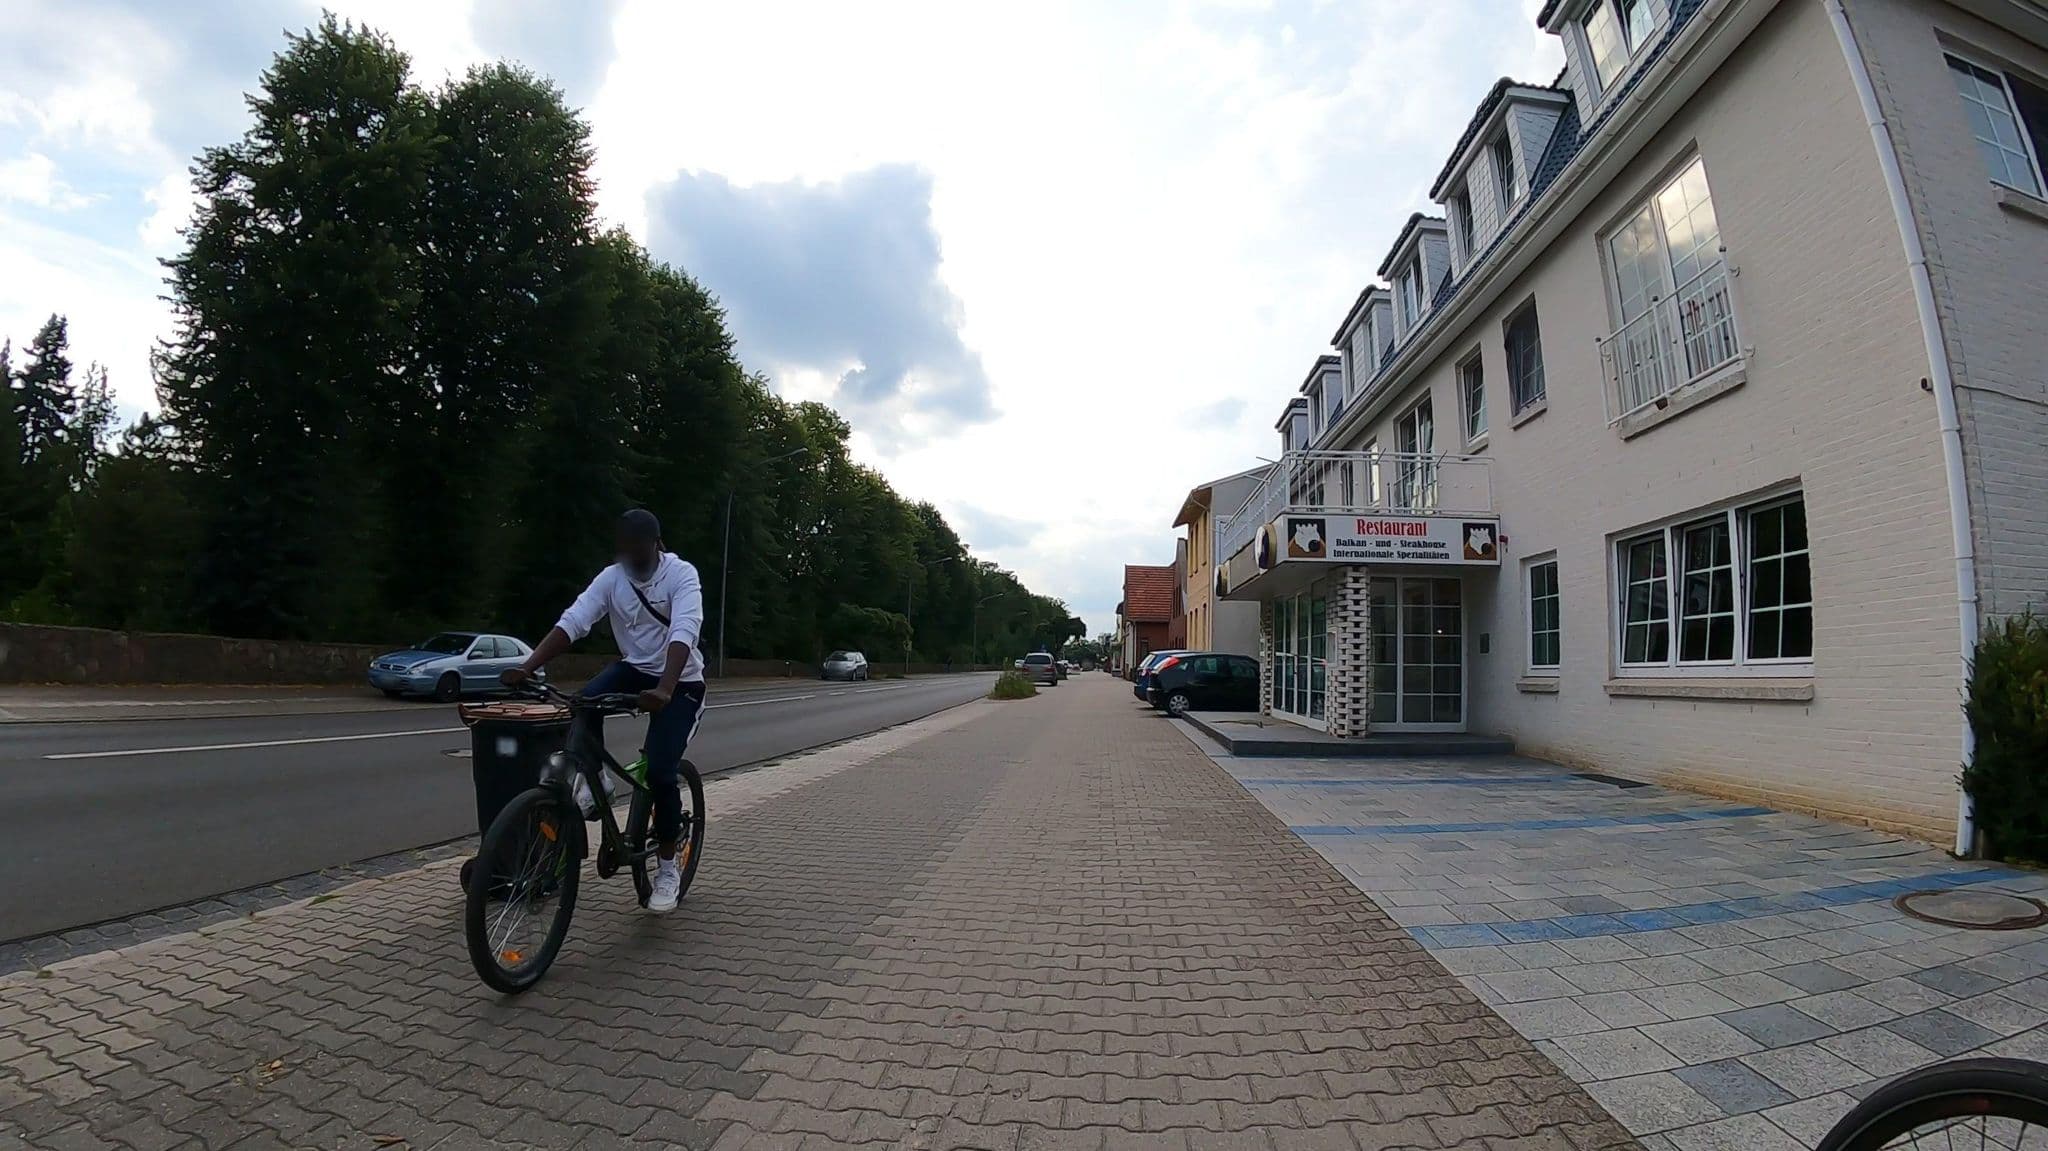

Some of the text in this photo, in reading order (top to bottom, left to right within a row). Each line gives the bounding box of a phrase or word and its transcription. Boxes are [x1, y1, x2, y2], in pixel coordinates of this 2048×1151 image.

[1356, 518, 1428, 537] Restaurant
[1336, 538, 1367, 547] Balkan
[1375, 539, 1391, 547] und
[1333, 549, 1450, 560] Internationale Spezialitäten
